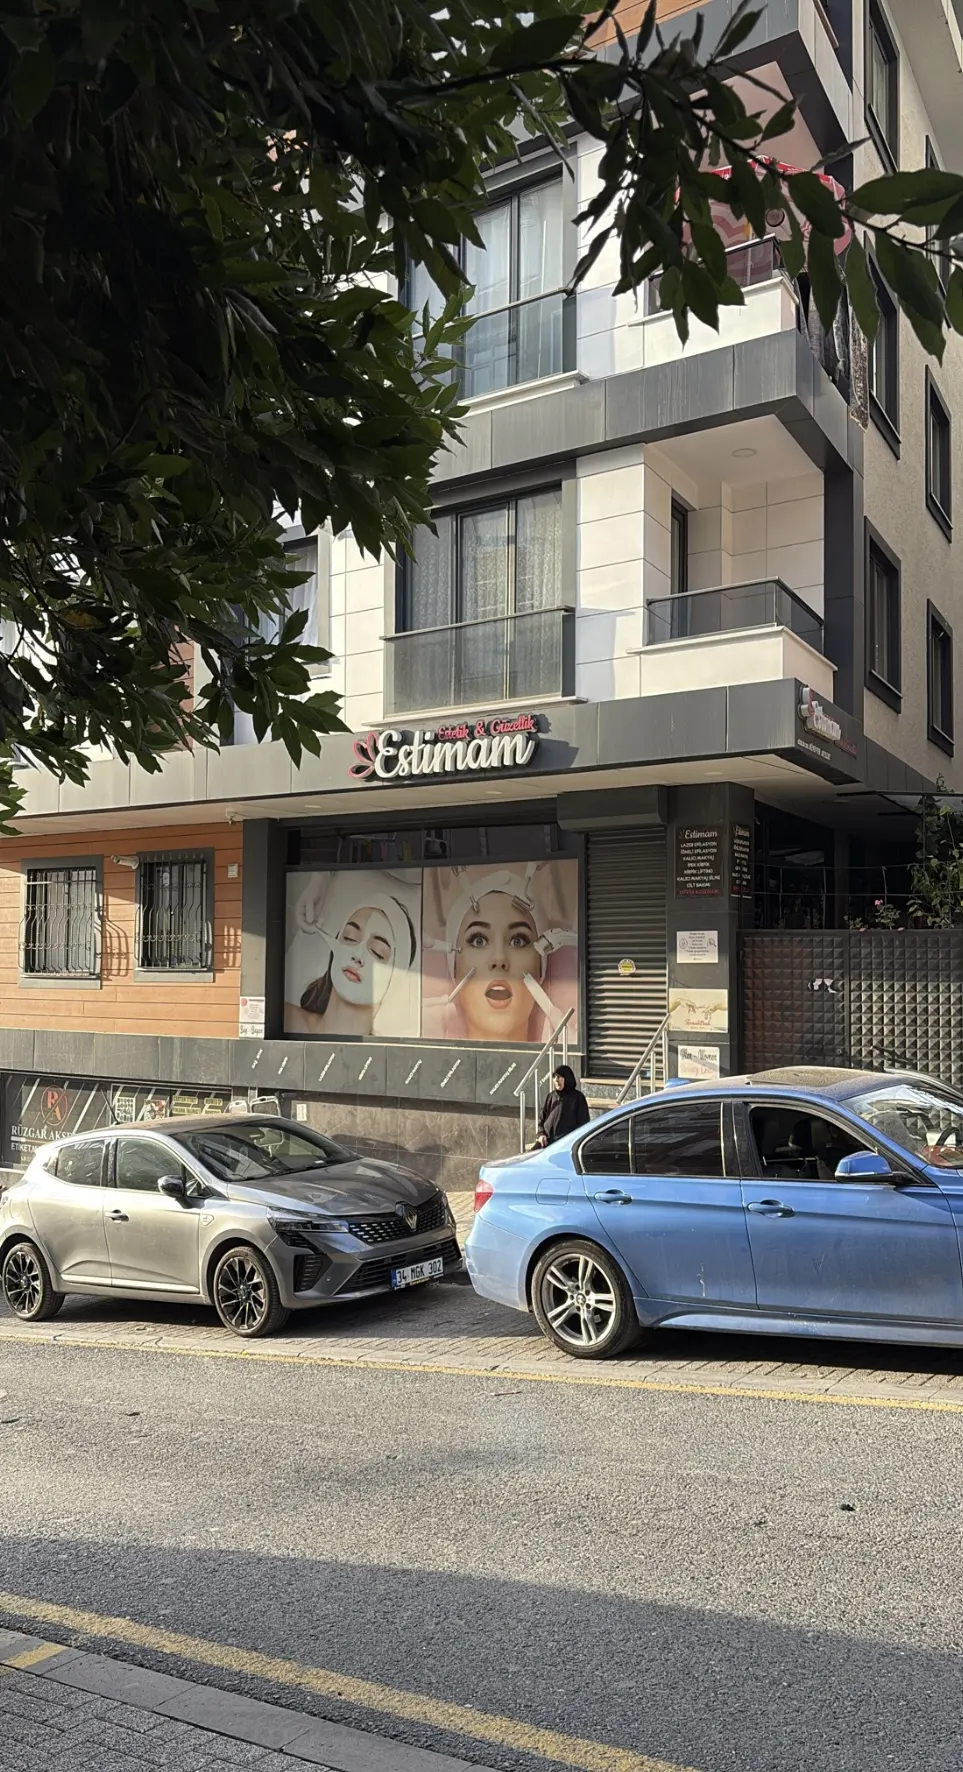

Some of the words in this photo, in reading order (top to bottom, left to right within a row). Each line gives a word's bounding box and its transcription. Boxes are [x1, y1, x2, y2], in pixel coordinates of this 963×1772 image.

[438, 725, 470, 741] Estetik
[474, 722, 486, 736] &
[490, 714, 538, 737] Güzellik
[374, 729, 536, 778] Estimam
[685, 830, 718, 839] Estimam
[397, 1270, 406, 1283] 34
[411, 1264, 424, 1279] MGK
[428, 1260, 441, 1274] 302
